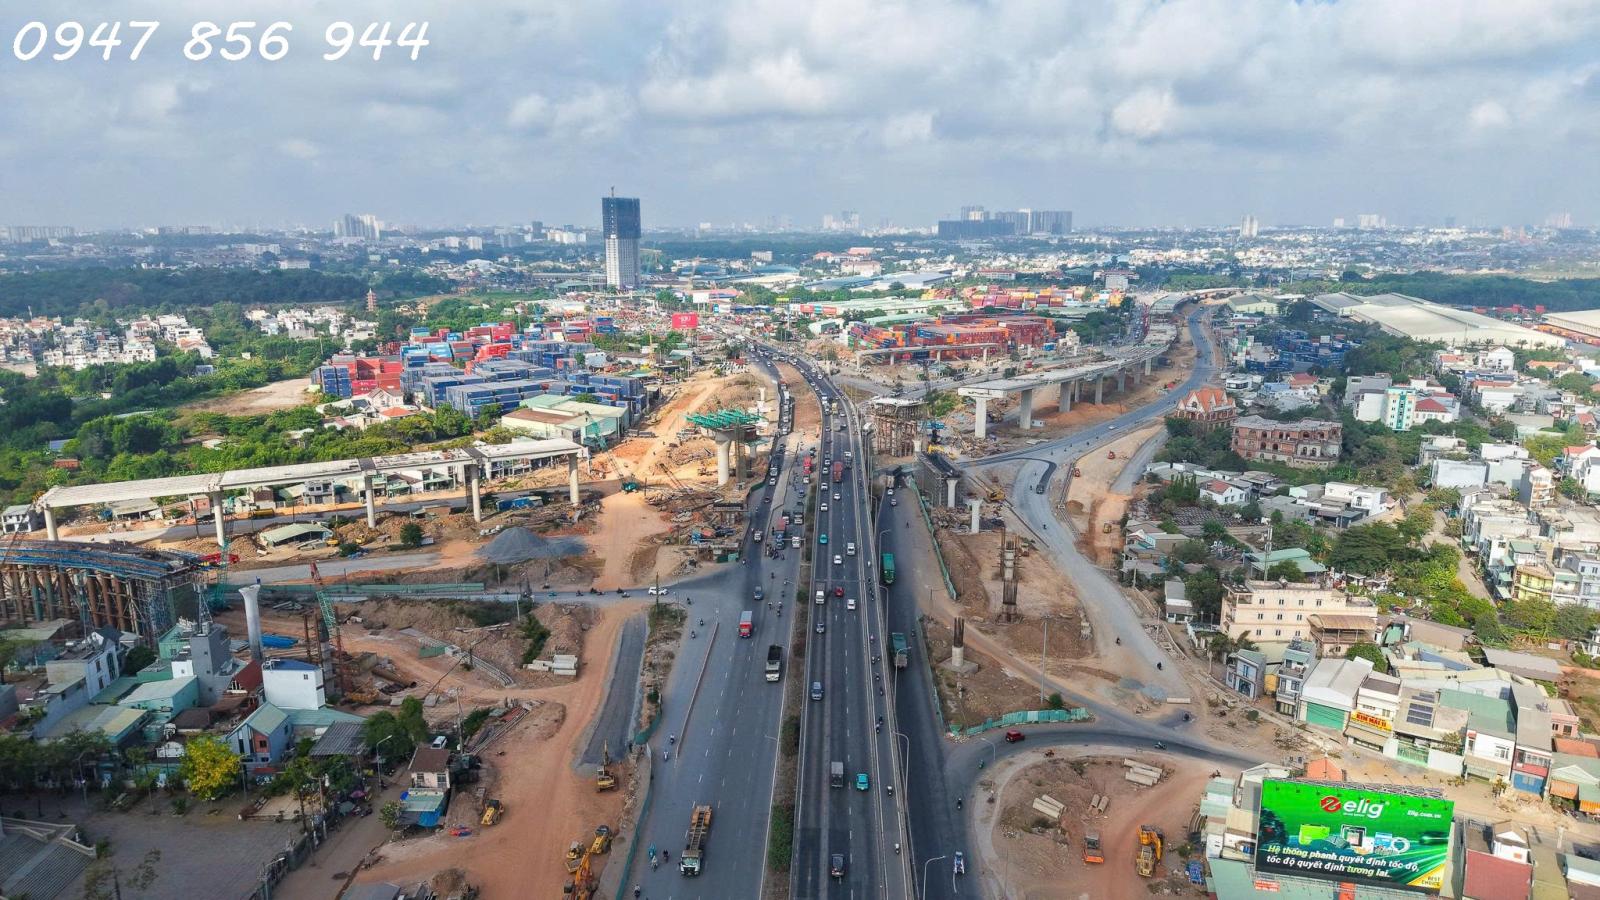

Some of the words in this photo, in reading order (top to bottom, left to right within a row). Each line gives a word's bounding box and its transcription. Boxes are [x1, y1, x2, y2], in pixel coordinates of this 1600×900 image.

[1343, 799, 1384, 819] elig
[1266, 854, 1282, 864] tốc
[1283, 857, 1296, 867] độ
[1297, 860, 1322, 870] quyết
[1324, 863, 1345, 872] định
[1267, 845, 1281, 855] Hệ
[1282, 846, 1308, 858] thống
[1308, 850, 1338, 861] phanh
[1338, 855, 1364, 865] quyết
[1365, 857, 1387, 867] định
[1388, 859, 1404, 869] tốc
